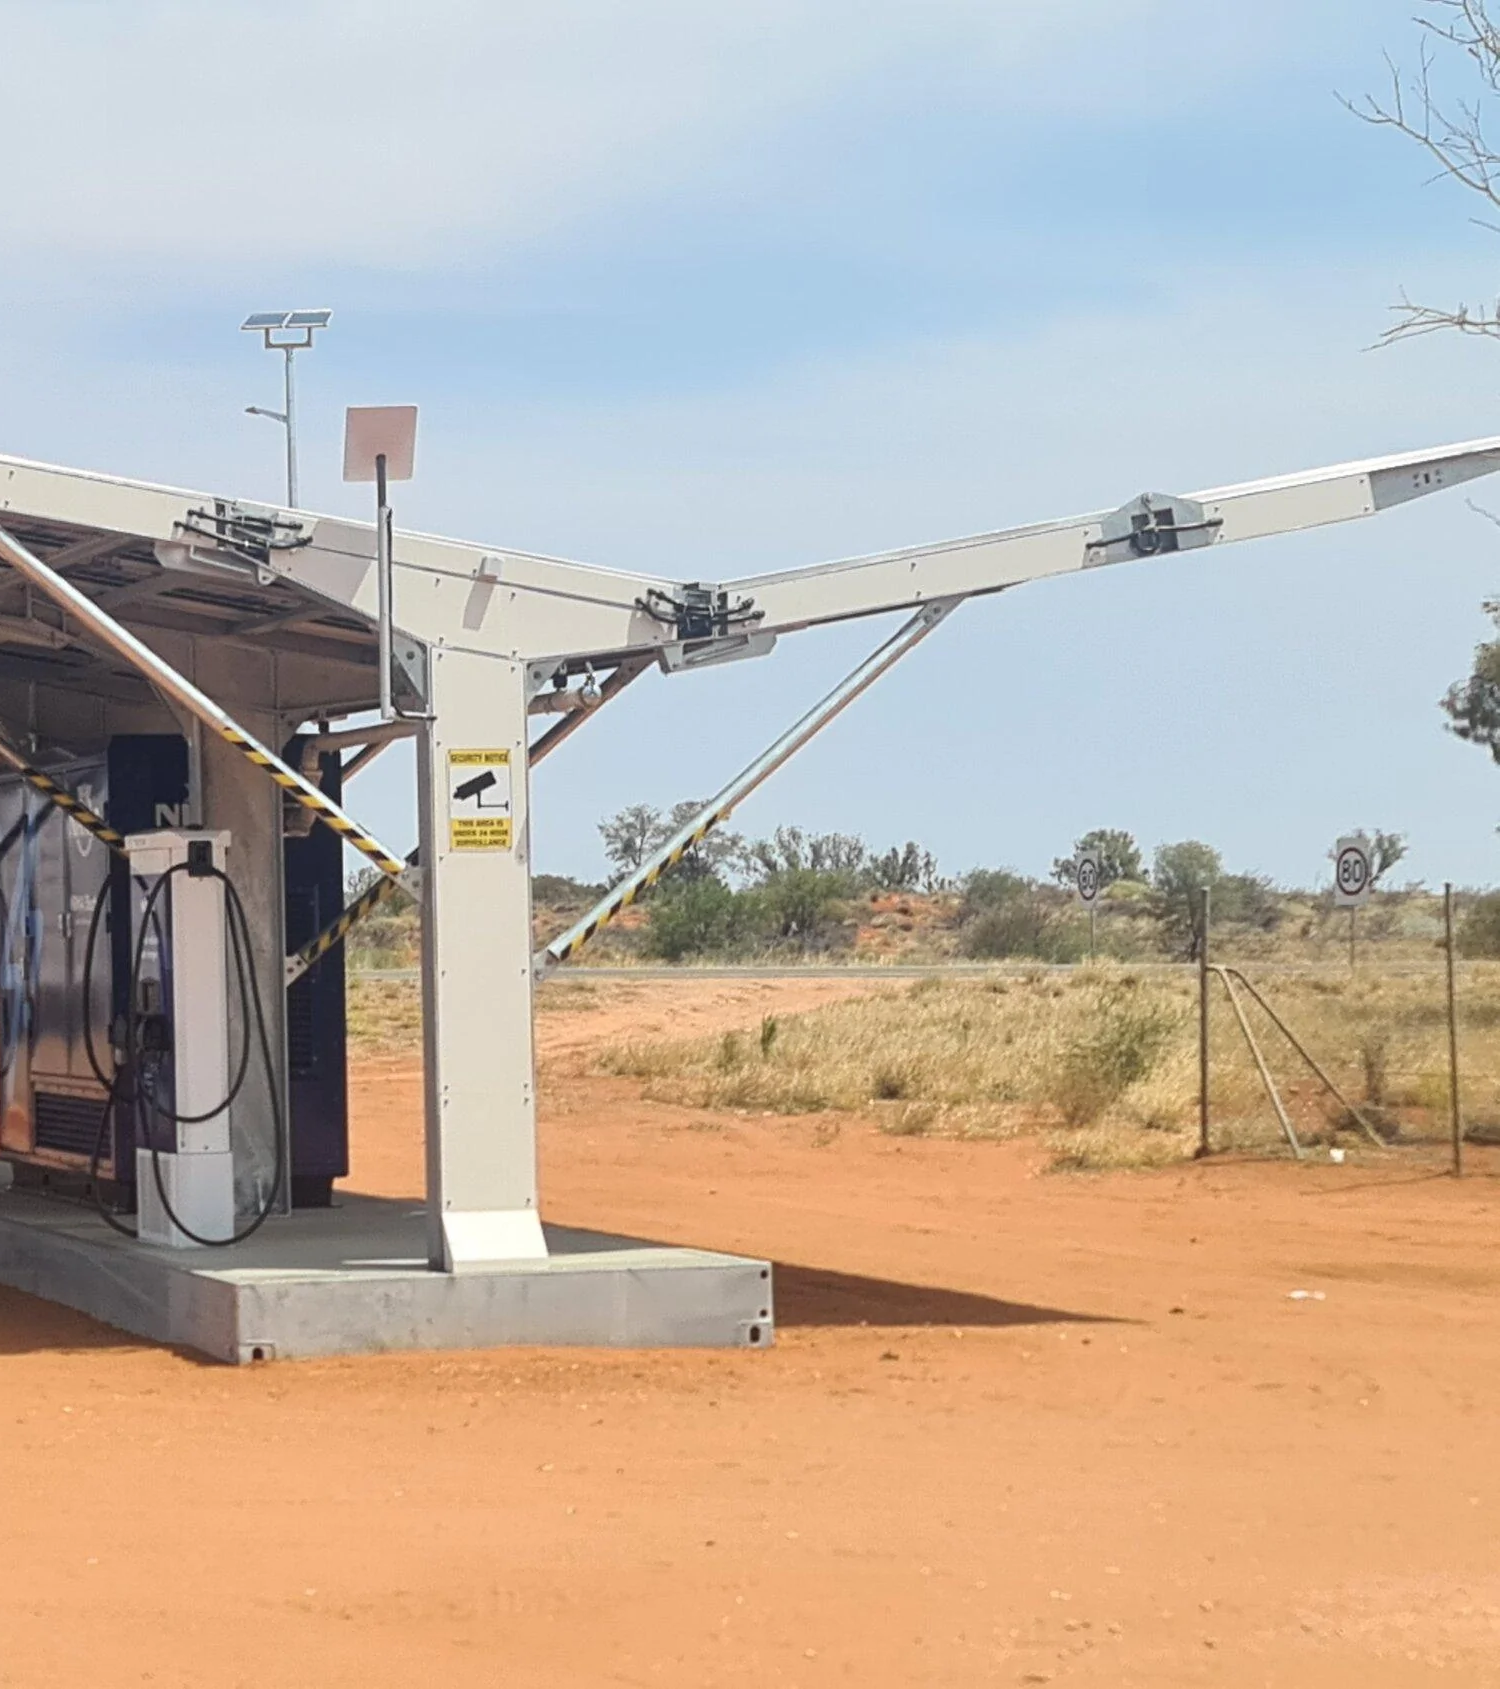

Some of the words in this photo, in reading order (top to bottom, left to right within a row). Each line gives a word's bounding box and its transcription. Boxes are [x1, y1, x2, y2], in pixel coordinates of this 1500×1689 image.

[450, 753, 482, 763] SECURITY
[484, 753, 508, 763] NOTICE
[1342, 859, 1365, 883] 80
